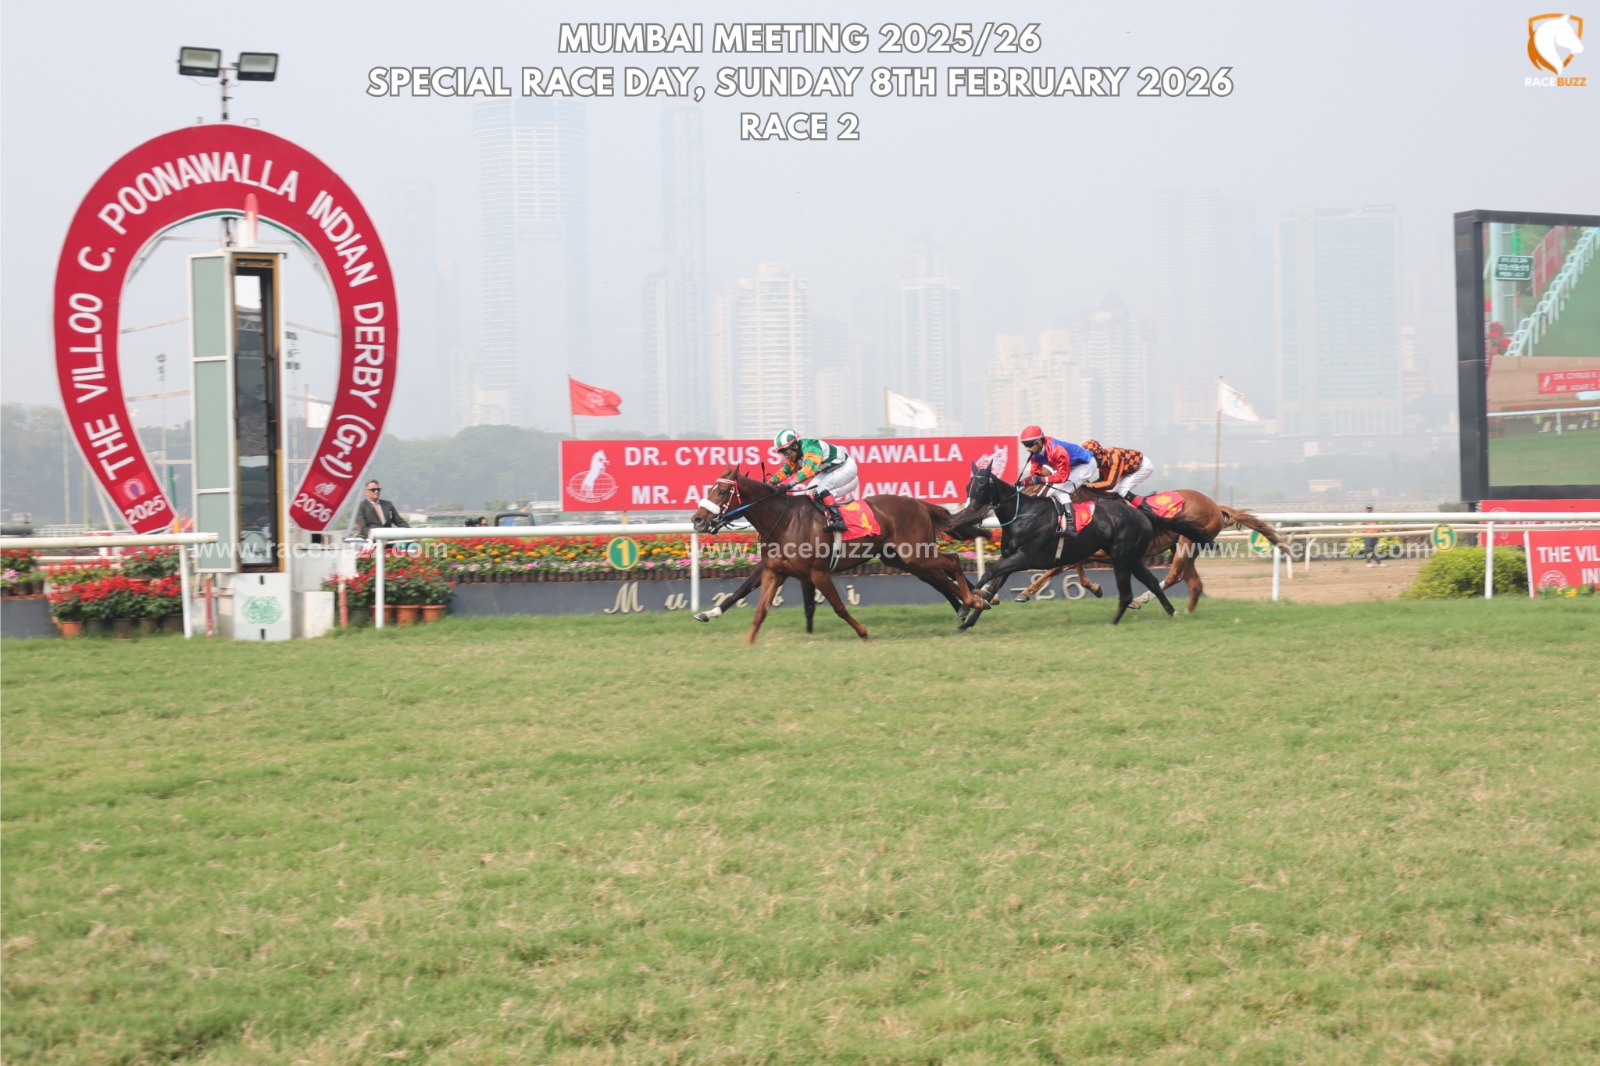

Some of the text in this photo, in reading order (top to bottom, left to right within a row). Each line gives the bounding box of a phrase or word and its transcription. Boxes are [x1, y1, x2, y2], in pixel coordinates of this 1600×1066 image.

[68, 151, 385, 480] THE VILLOO C. POONAWALLA INDIAN DERBY (Gr-1)
[624, 446, 667, 466] DR.
[675, 446, 761, 466] CYRUS
[631, 485, 677, 504] MR.
[125, 494, 167, 525] 2025
[292, 493, 333, 523] 2026
[1438, 527, 1451, 550] 5
[616, 540, 629, 567] 1
[1536, 545, 1572, 563] THE
